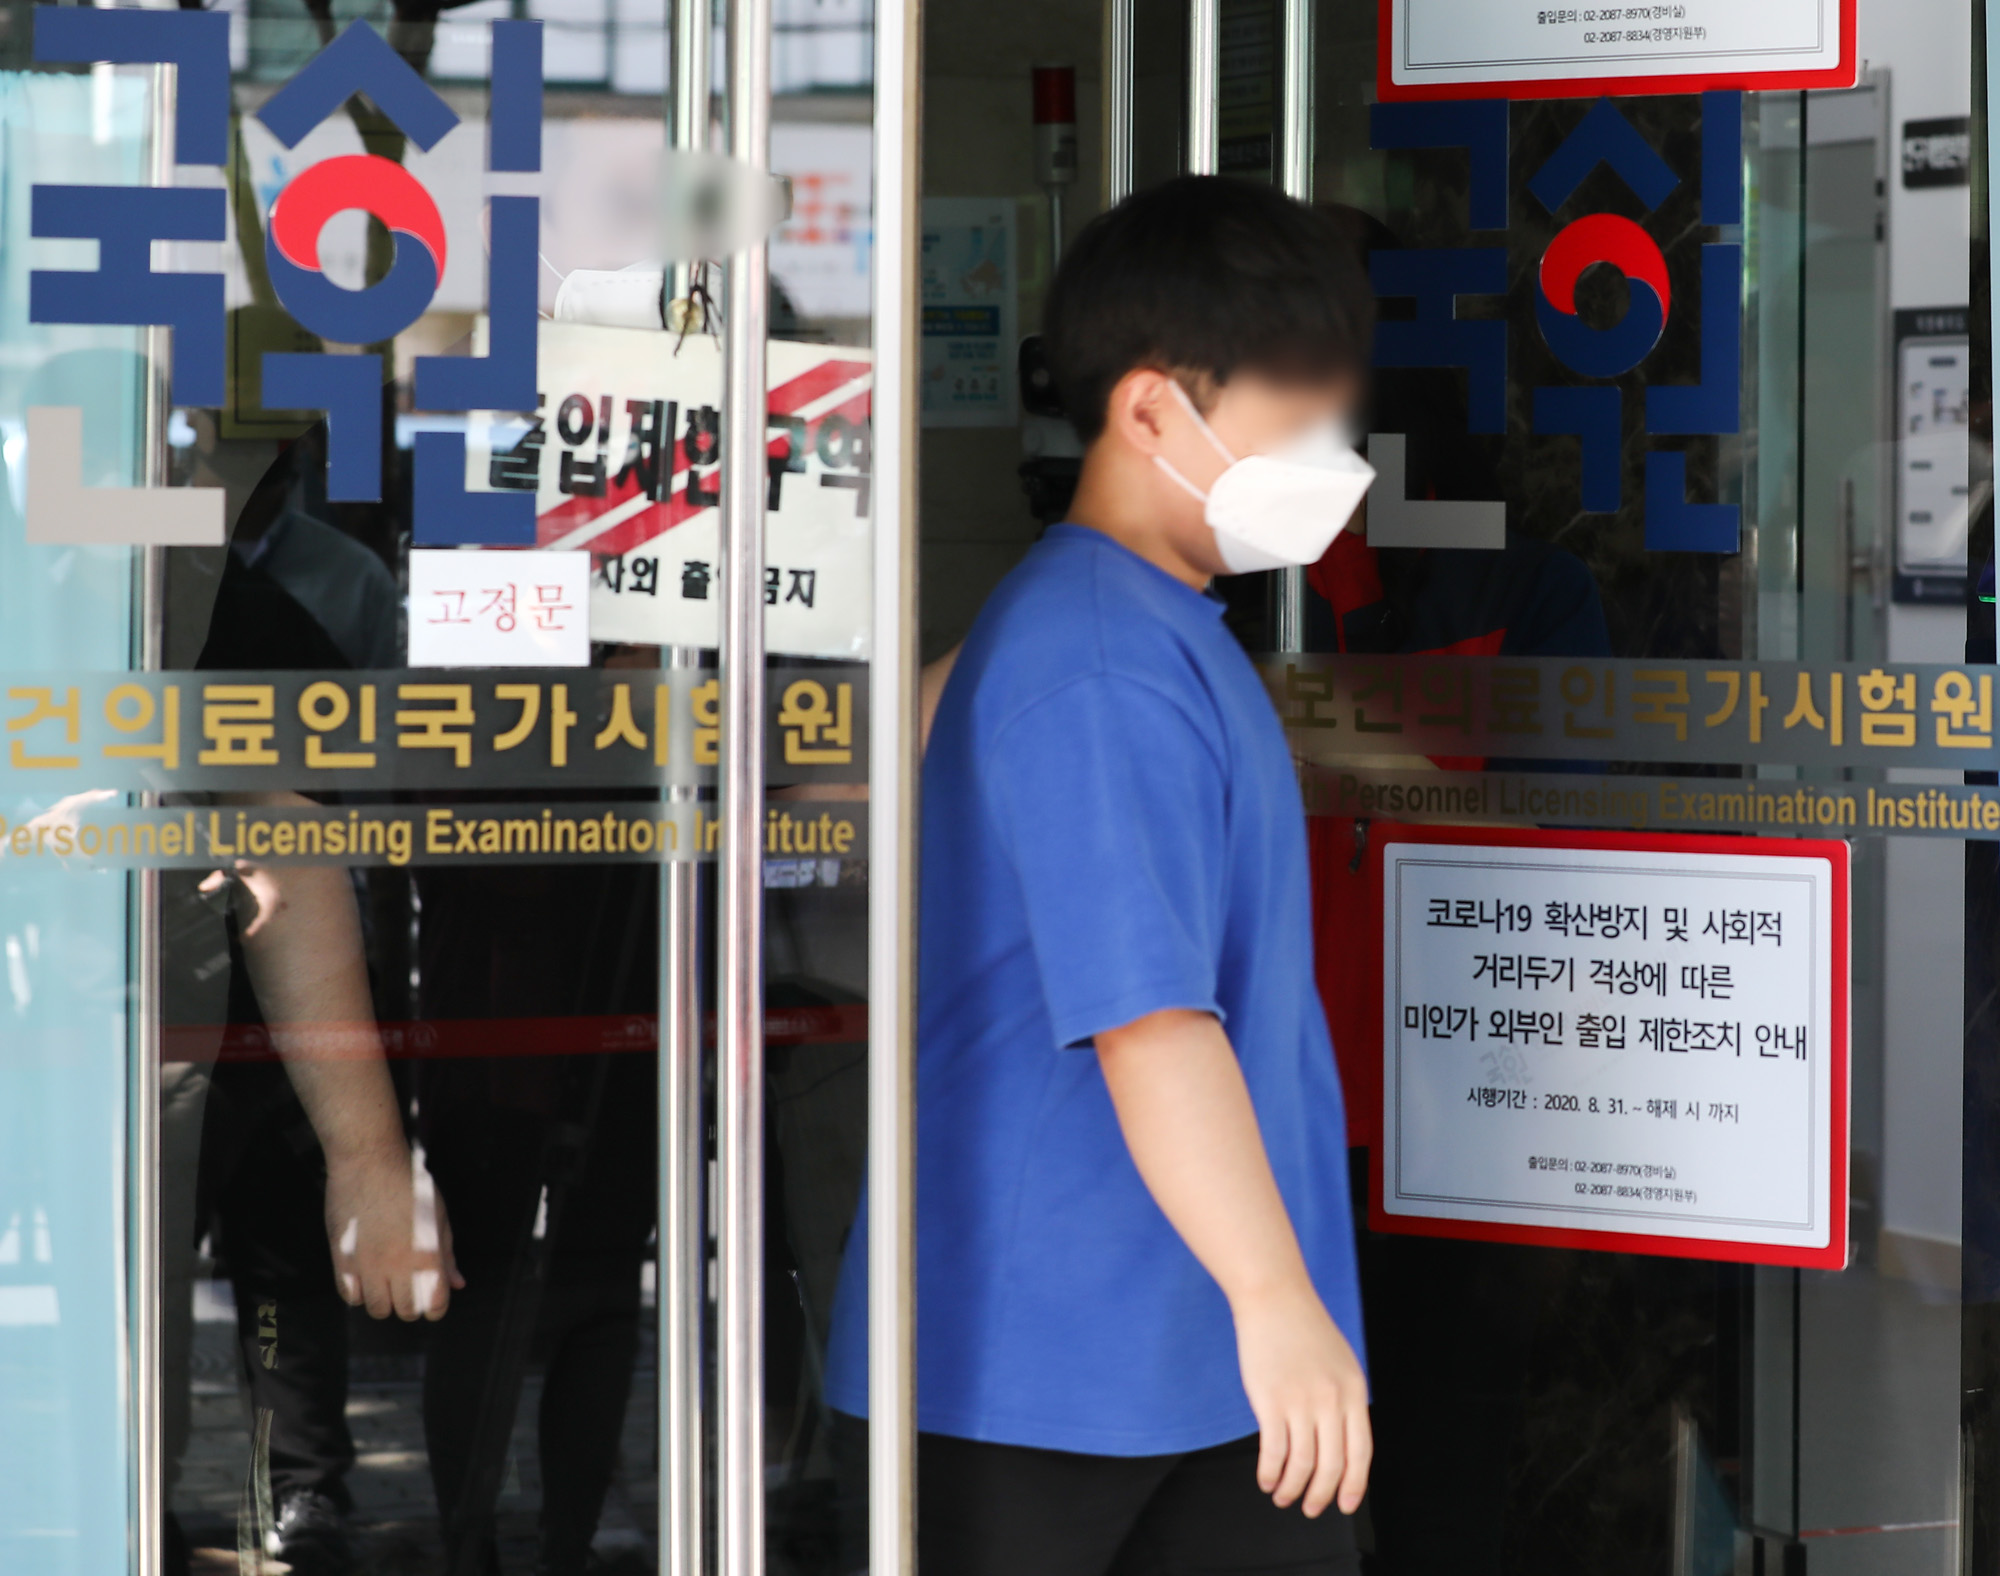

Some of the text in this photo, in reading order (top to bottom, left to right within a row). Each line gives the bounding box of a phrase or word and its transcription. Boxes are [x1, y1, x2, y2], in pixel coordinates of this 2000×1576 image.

[1536, 9, 1577, 25] 출입문의
[426, 581, 574, 634] 고정문
[681, 560, 817, 608] 출금지
[1256, 661, 1994, 750] 보건의료인국가시험원
[1339, 774, 1489, 815] Personnel
[1499, 777, 1650, 829] Licensing
[1659, 781, 1857, 827] Examination
[1866, 788, 2000, 832] Institute
[209, 810, 413, 866] Licensing
[426, 809, 678, 854] Examination
[692, 809, 856, 854] Initute
[1426, 898, 1783, 947] 코로나19 확산방지 및 사회적
[1472, 953, 1736, 1001] 거리두기 격상에 따른
[1404, 1003, 1809, 1062] 미인가 외부인 출입 제한조치 안내
[1466, 1086, 1527, 1110] 시행기간
[1544, 1093, 1582, 1112] 2020.
[1588, 1096, 1600, 1114] 8.
[1646, 1098, 1678, 1119] 해제
[1685, 1101, 1700, 1121] 시
[1707, 1102, 1740, 1124] 까지
